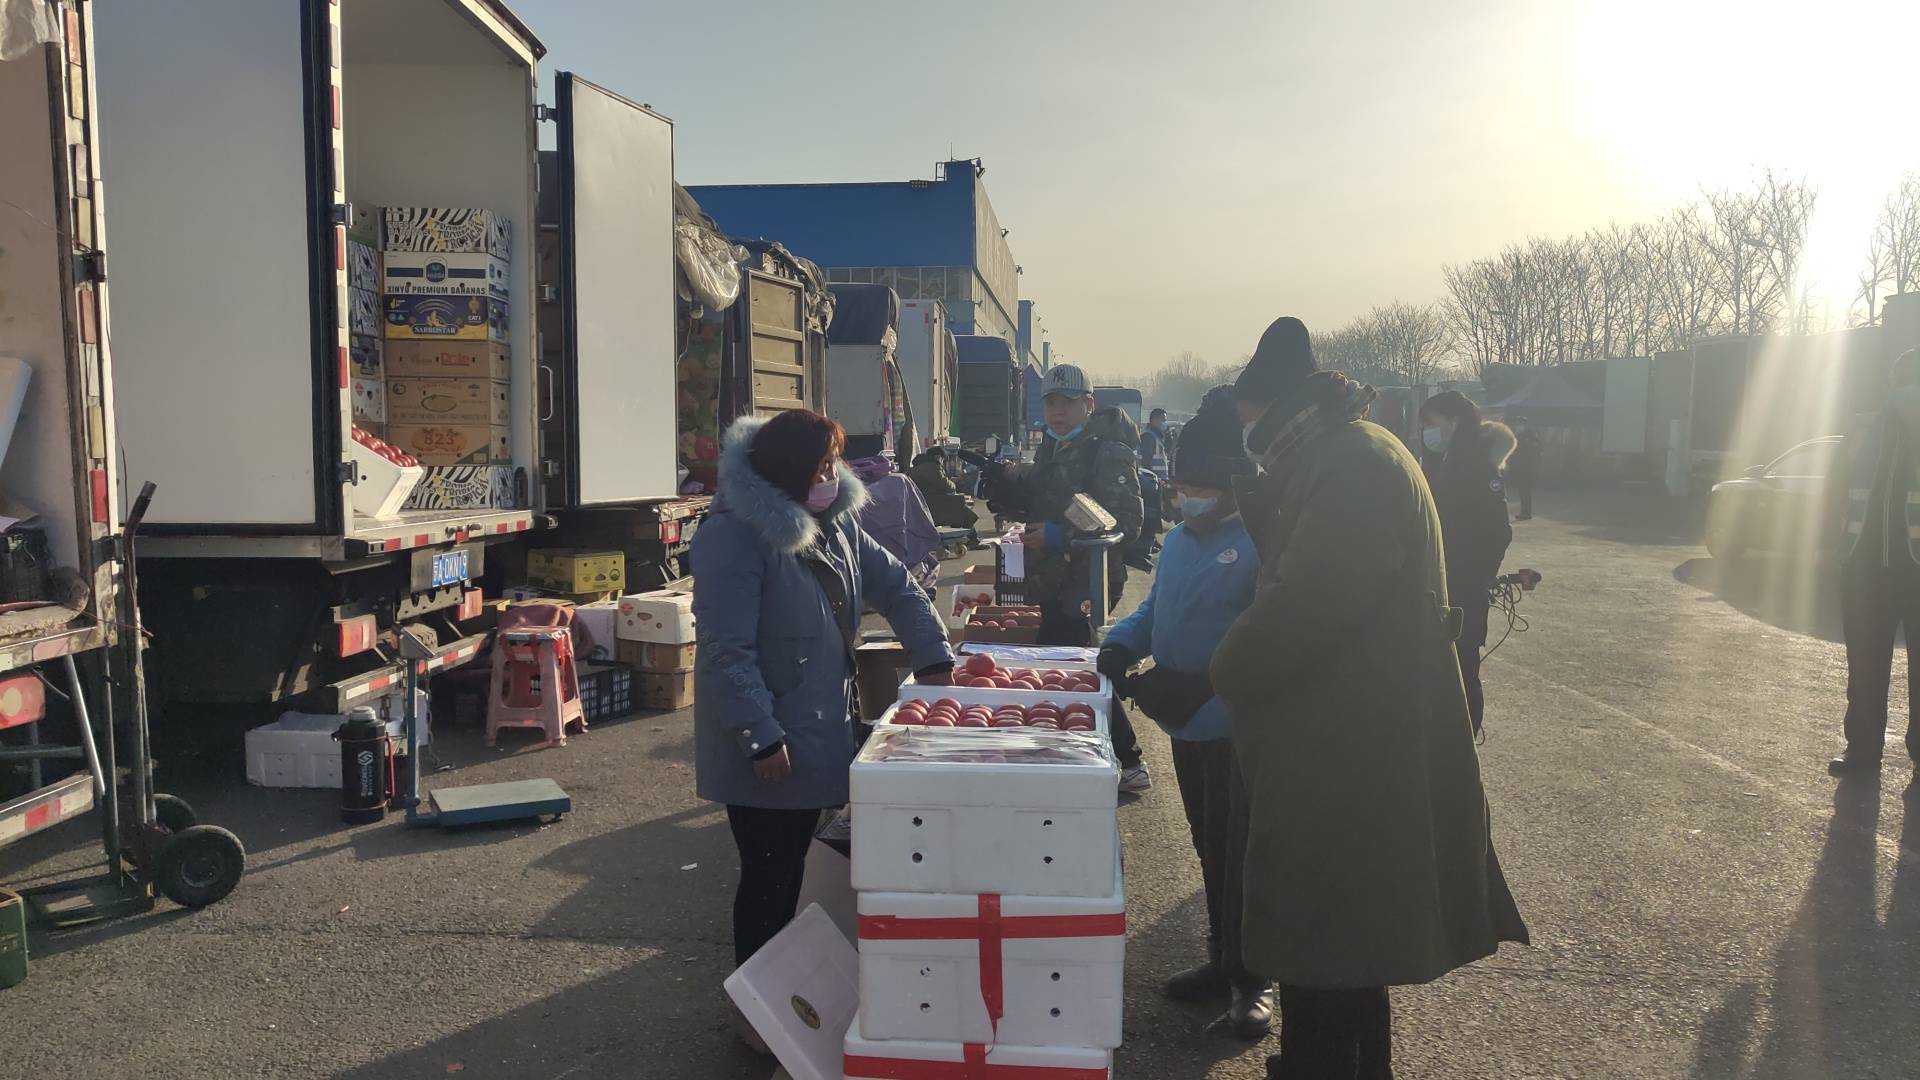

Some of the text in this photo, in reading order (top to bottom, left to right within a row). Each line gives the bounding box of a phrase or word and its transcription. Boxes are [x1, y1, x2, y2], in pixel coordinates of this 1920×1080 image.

[412, 286, 448, 294] PREMIUM
[450, 286, 486, 295] BANANAS
[424, 432, 455, 446] 823
